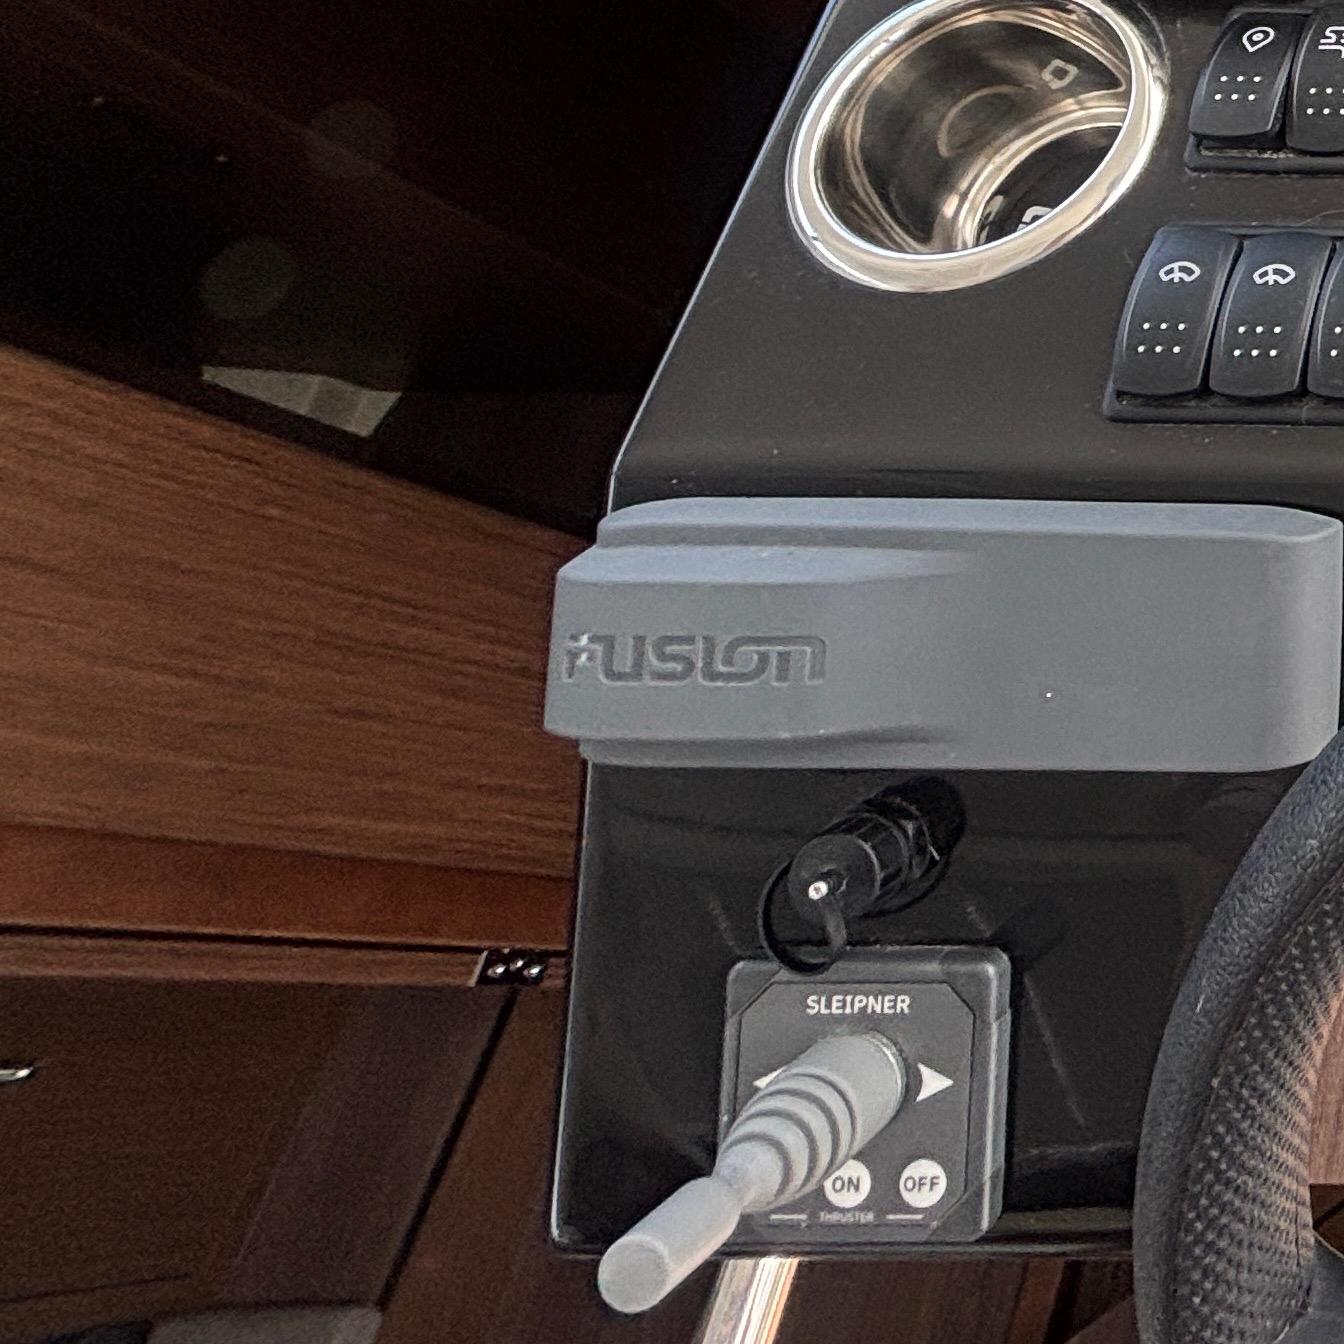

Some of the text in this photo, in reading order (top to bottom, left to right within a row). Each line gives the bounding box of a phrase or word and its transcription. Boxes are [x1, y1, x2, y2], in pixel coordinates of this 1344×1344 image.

[805, 994, 911, 1015] SLEIPNER
[831, 1174, 941, 1193] ON OFF
